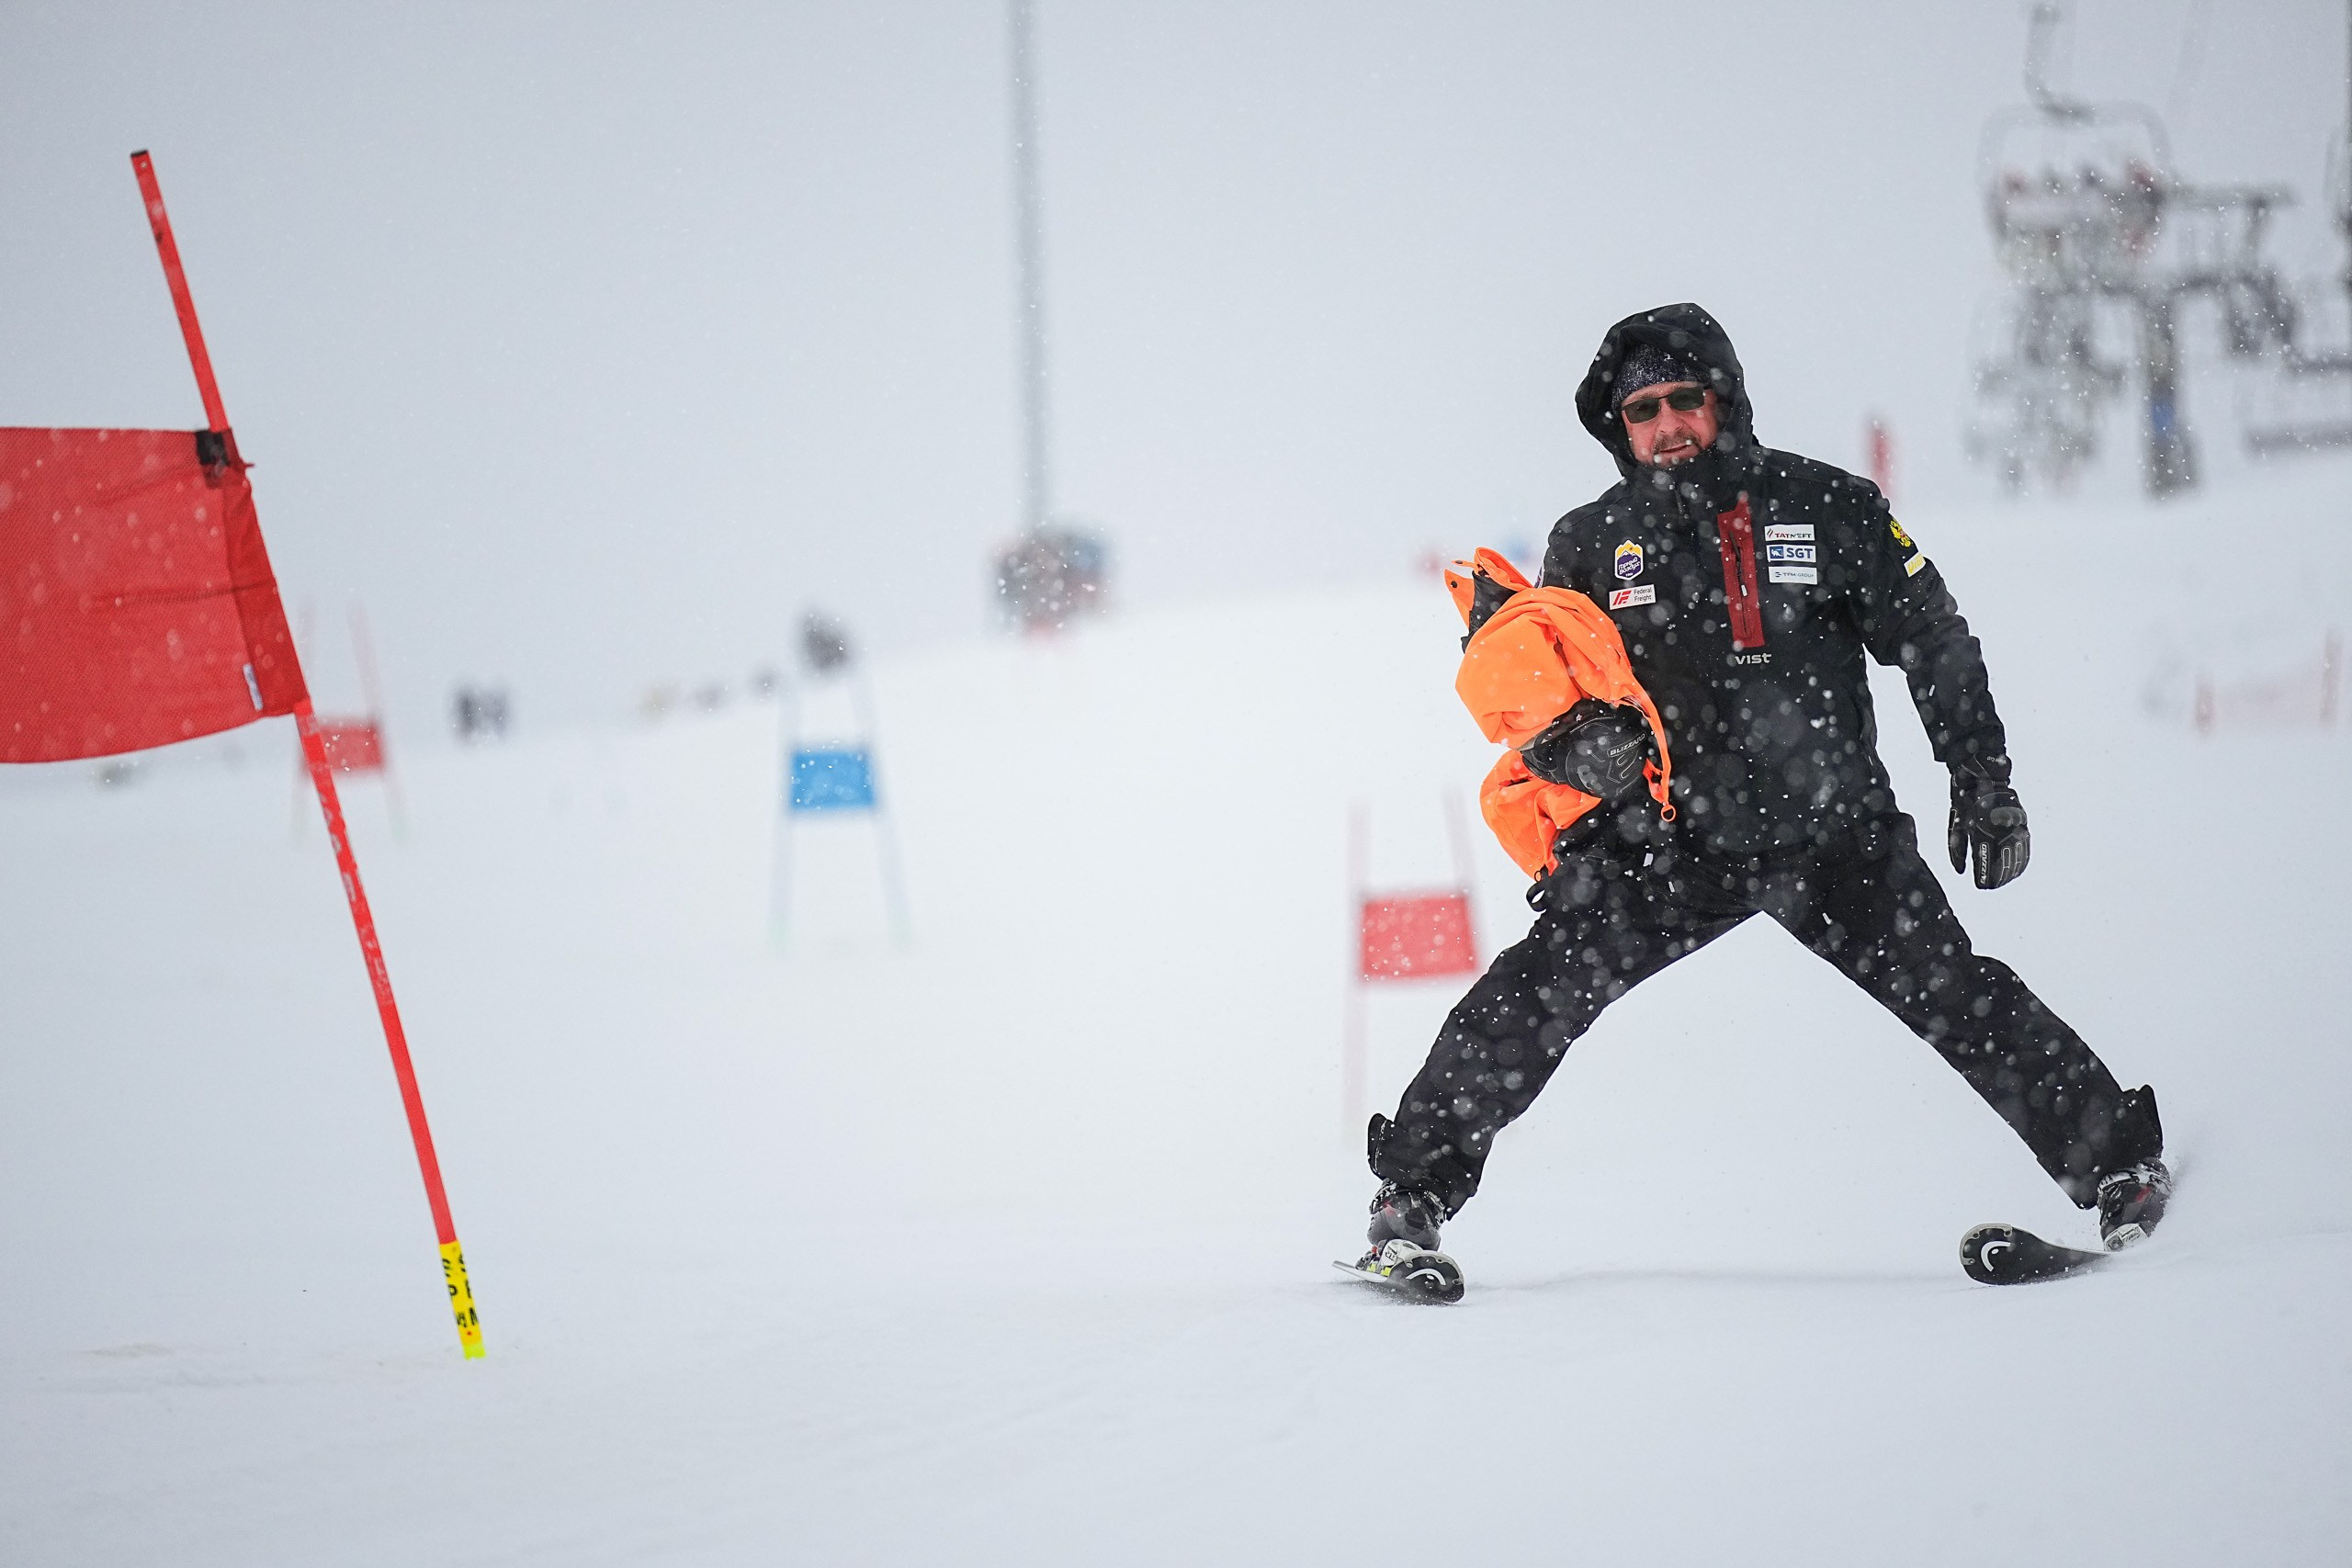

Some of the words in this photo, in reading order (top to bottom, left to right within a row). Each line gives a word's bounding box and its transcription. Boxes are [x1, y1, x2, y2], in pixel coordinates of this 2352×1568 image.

[1786, 547, 1813, 558] SGT
[1634, 587, 1652, 595] Federal
[1610, 733, 1645, 756] BLIZZARD
